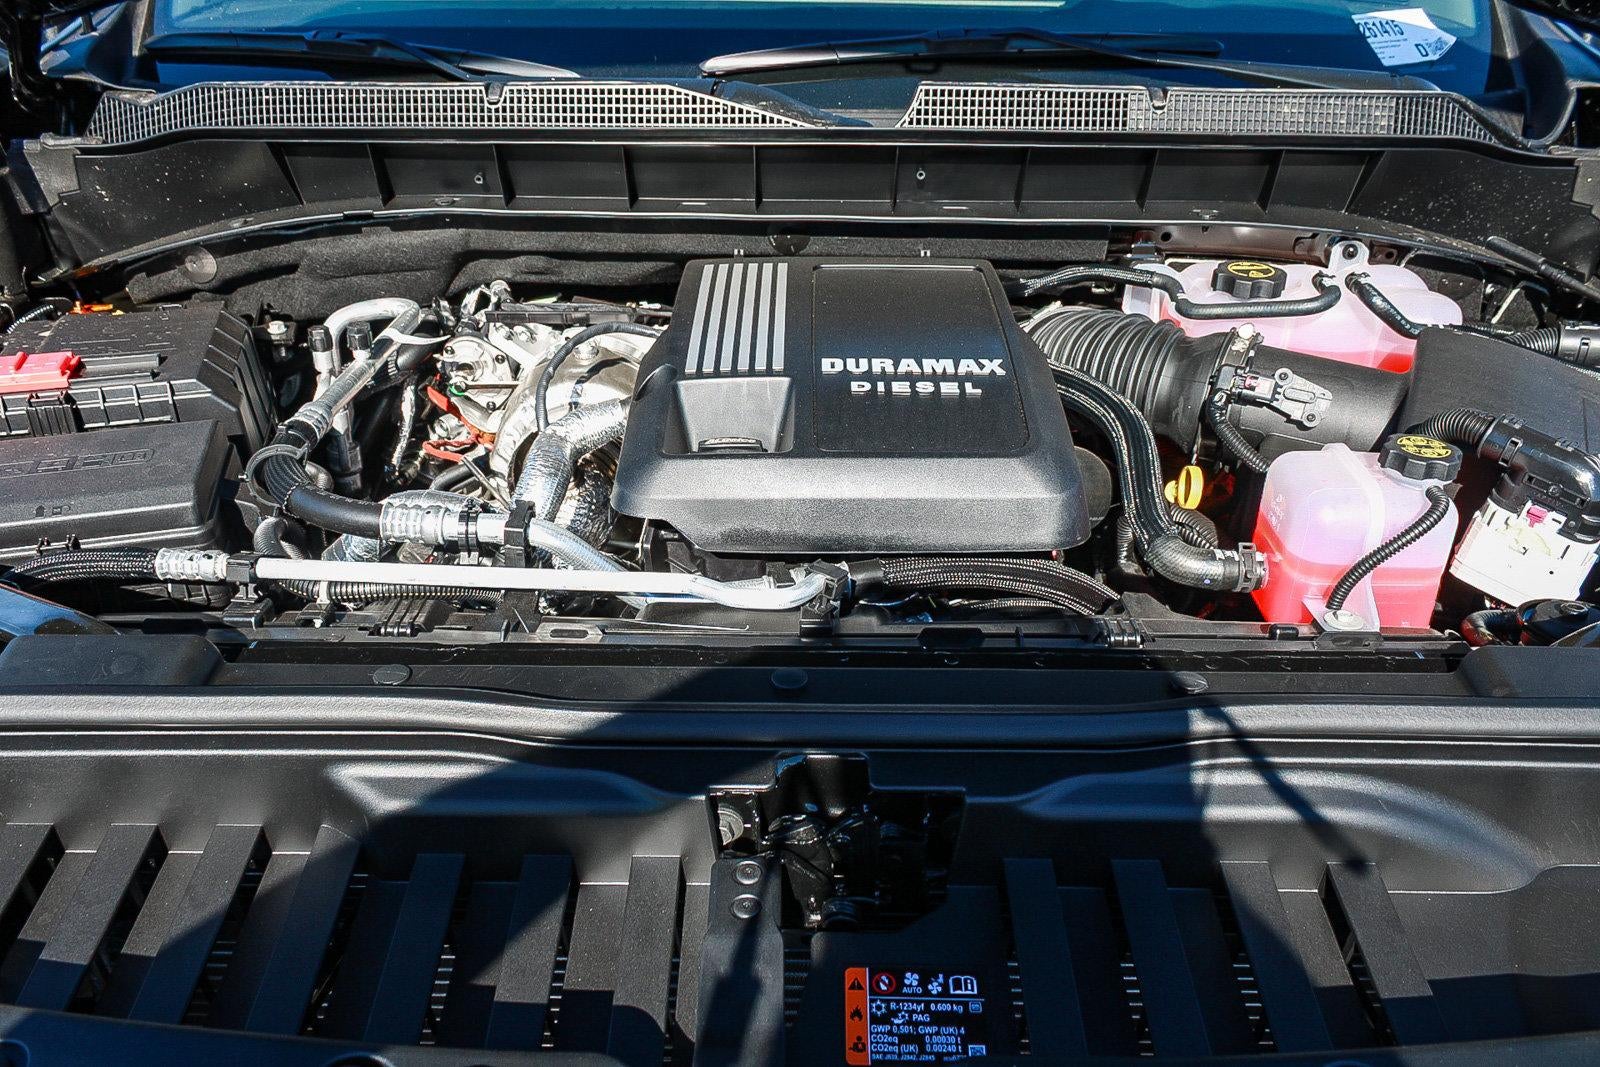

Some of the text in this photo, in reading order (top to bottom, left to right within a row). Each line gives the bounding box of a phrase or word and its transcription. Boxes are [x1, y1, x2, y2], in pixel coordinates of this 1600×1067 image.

[1357, 19, 1404, 39] 261415
[1414, 43, 1429, 57] D
[821, 358, 1006, 375] DURAMAX
[850, 381, 982, 396] DIESEL
[890, 1002, 963, 1013] R-1234yf 0.600 kg
[912, 1013, 930, 1021] PAG
[870, 1025, 890, 1033] GWP
[918, 1026, 938, 1034] GWP
[940, 1026, 958, 1035] (UK)
[870, 1035, 898, 1044] CO2eq
[957, 1036, 961, 1044] t
[871, 1043, 899, 1052] CO2eq
[900, 1044, 919, 1053] (UK)
[926, 1044, 956, 1052] 0.00240
